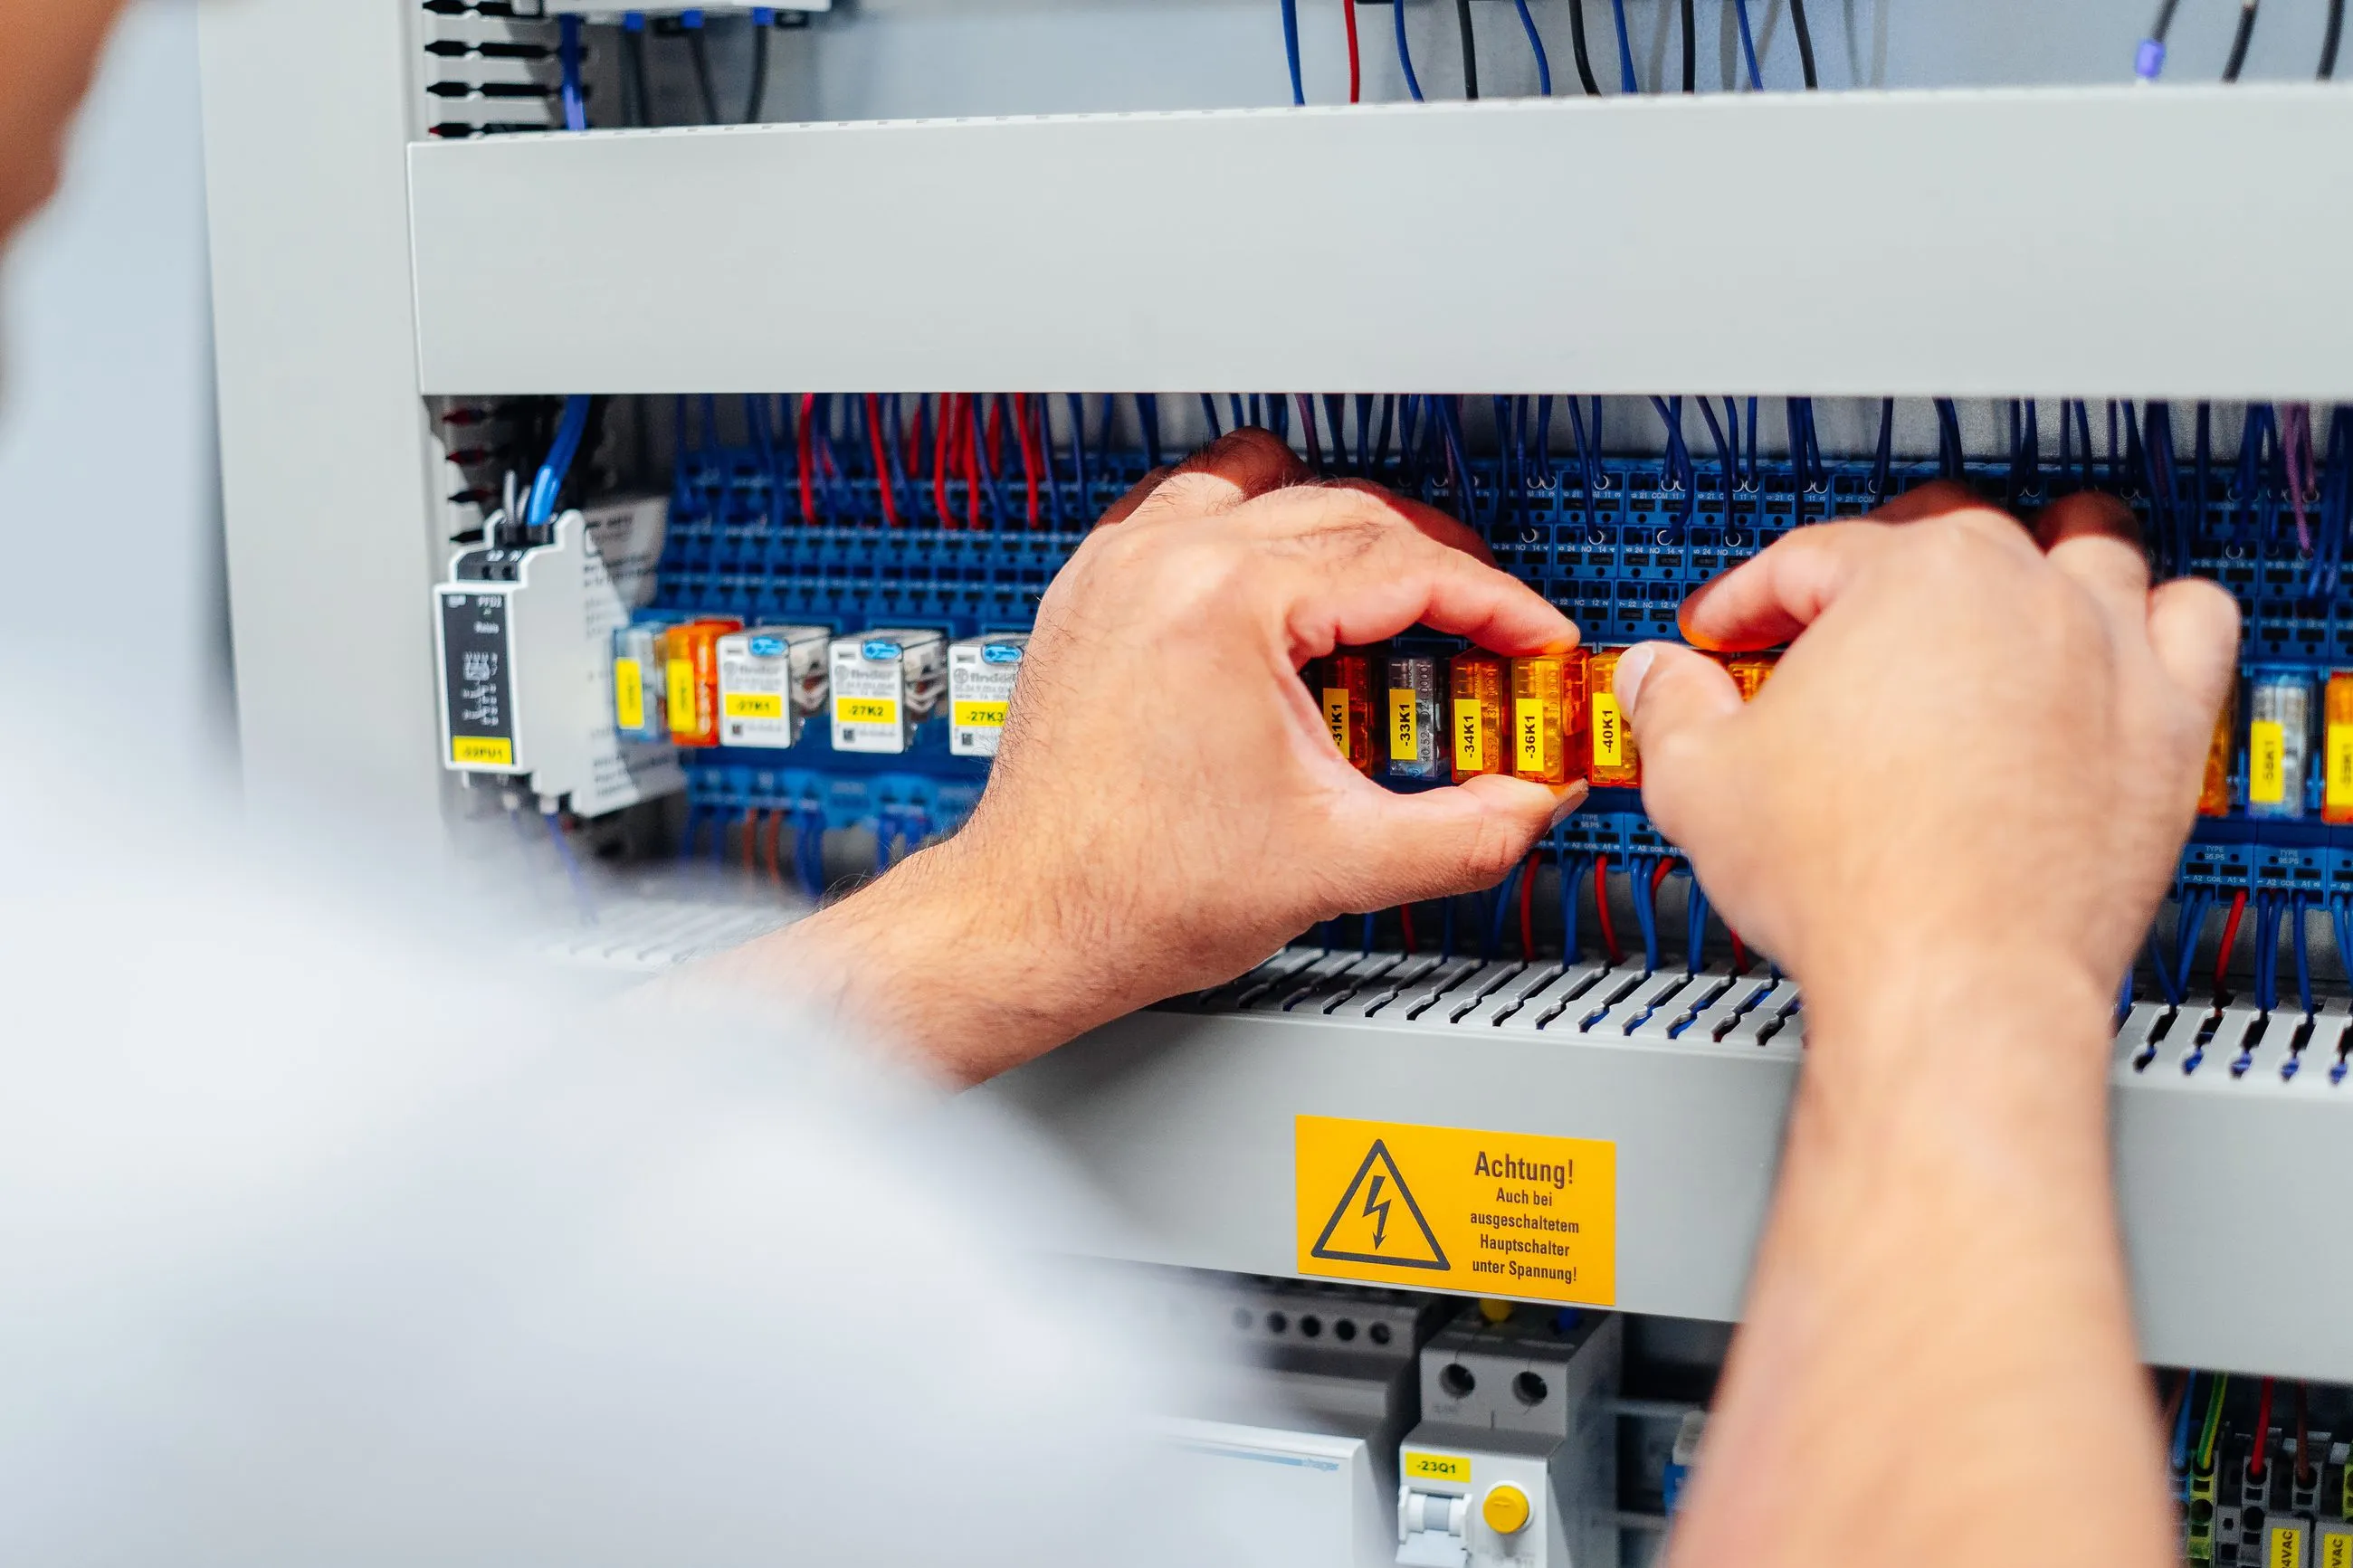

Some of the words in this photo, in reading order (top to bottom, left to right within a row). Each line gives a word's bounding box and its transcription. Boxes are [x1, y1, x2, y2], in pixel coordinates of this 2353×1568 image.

[1652, 491, 1668, 499] COM
[1515, 543, 1527, 551] NO
[1581, 546, 1593, 554] NO
[1634, 546, 1643, 555] 24
[1649, 546, 1662, 555] NO
[1667, 546, 1676, 556] 14
[1702, 548, 1711, 556] 24
[1717, 548, 1729, 557] NO
[1574, 599, 1586, 607] NC
[1591, 599, 1600, 607] 12
[1627, 600, 1637, 609] 22
[1643, 602, 1654, 610] NC
[1660, 601, 1669, 610] 12
[851, 669, 895, 680] finder
[849, 705, 884, 717] -27K2
[967, 711, 1005, 723] -27K3
[1331, 704, 1343, 746] -31K1
[1399, 704, 1411, 746] -33K1
[1463, 716, 1475, 758] -34K1
[1524, 716, 1536, 758] -36K1
[1602, 710, 1614, 754] -40K1
[2205, 845, 2224, 853] TYPE
[2193, 874, 2203, 882] A2
[2227, 876, 2236, 884] A1
[2266, 878, 2277, 887] A2
[2301, 879, 2311, 888] A1
[1473, 1150, 1574, 1190] Achtung!
[1496, 1186, 1529, 1205] Auch
[1533, 1190, 1553, 1207] bei
[1470, 1211, 1579, 1234] ausgeschaltetem
[1480, 1233, 1570, 1257] Hauptschalter
[1472, 1259, 1506, 1276] unter
[1509, 1260, 1577, 1285] Spannung!
[1416, 1460, 1456, 1475] -23Q1
[2281, 1530, 2293, 1568] 4VAC
[2331, 1538, 2344, 1568] VAC
